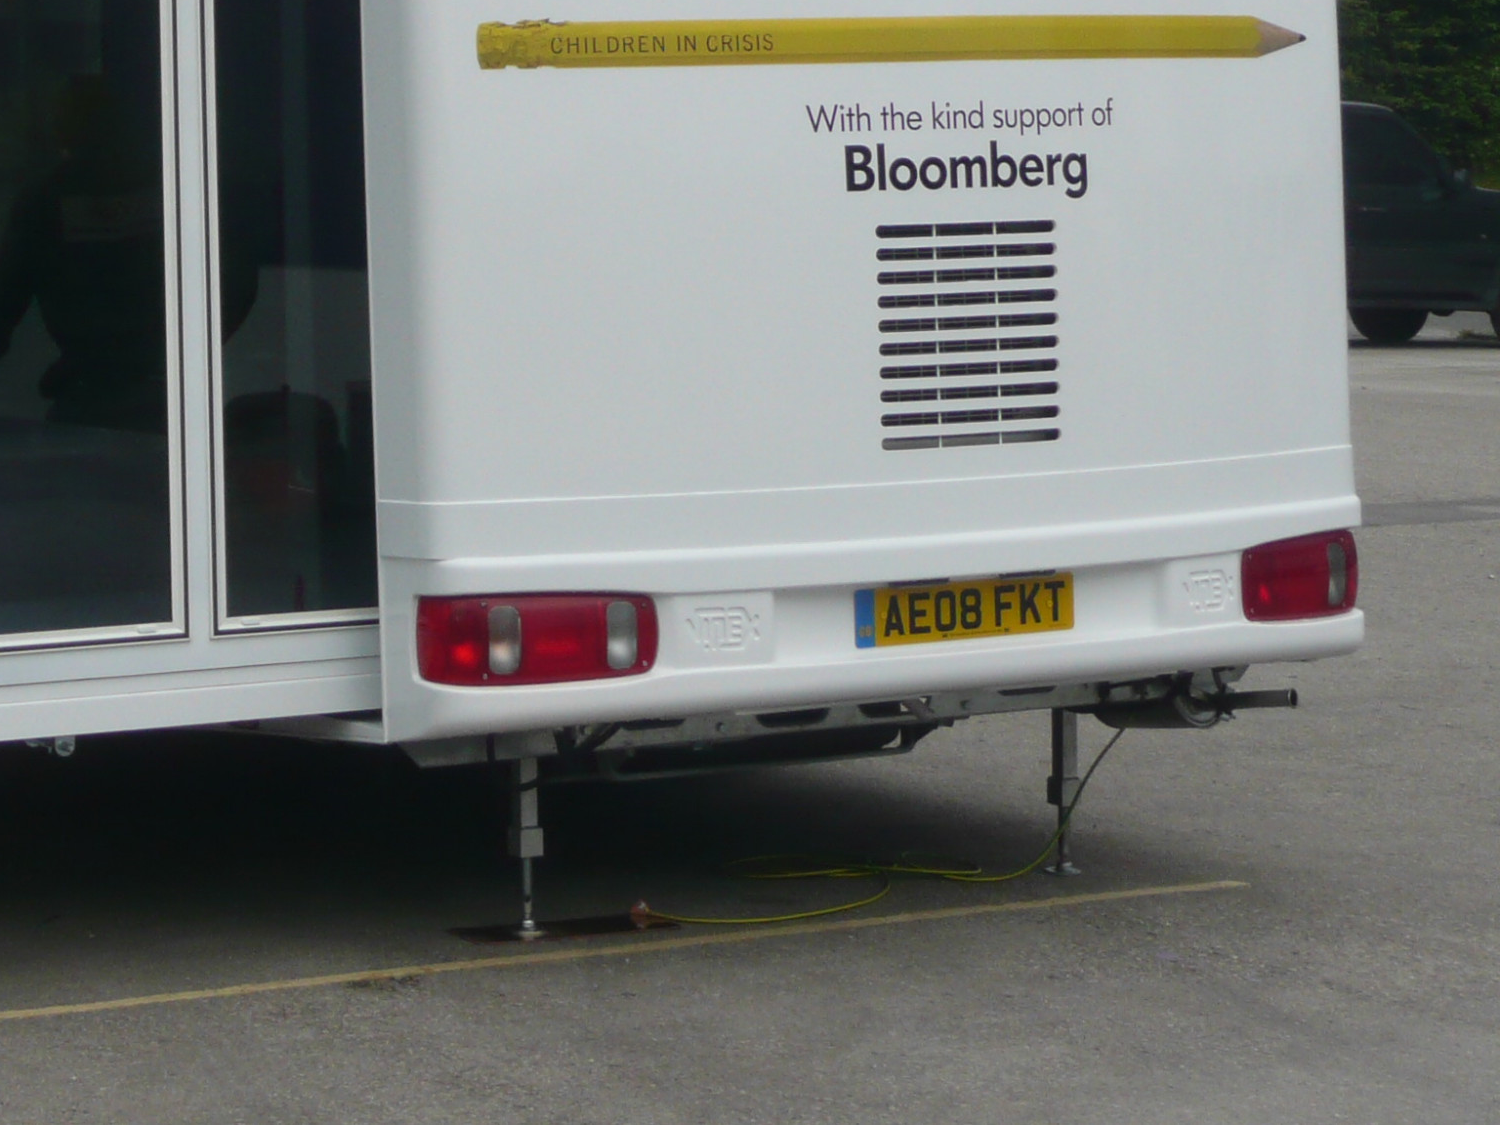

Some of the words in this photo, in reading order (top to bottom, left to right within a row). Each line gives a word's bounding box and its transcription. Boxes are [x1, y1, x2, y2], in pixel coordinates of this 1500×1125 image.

[550, 35, 666, 55] CHILDREN
[677, 34, 698, 54] IN
[706, 33, 775, 54] CRISIS
[806, 101, 871, 134] With
[879, 101, 923, 133] the
[932, 100, 984, 131] kind
[992, 103, 1083, 137] support
[1091, 96, 1114, 127] of
[845, 141, 1090, 199] Bloomberg
[884, 588, 983, 637] AE08
[994, 581, 1066, 627] FKT
